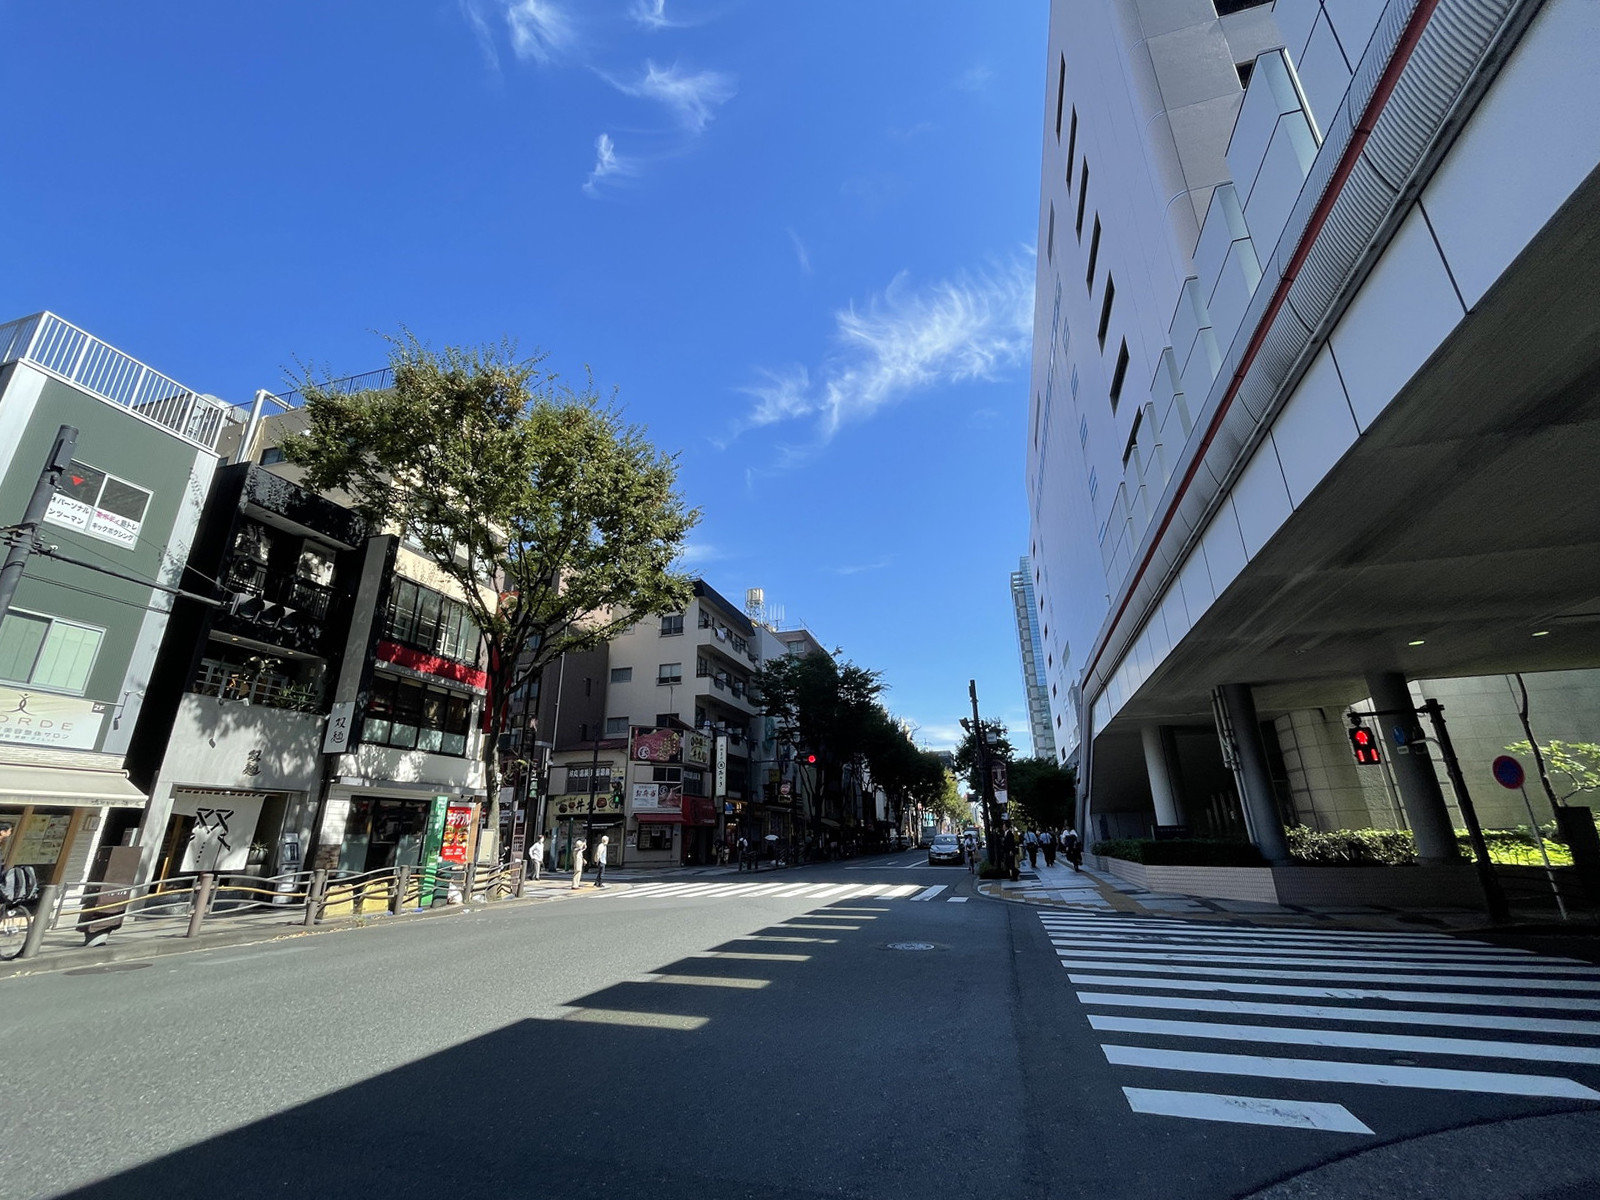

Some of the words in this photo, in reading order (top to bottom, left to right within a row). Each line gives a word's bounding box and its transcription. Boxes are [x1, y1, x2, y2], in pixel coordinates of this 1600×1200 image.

[92, 522, 134, 542] キックボクシング
